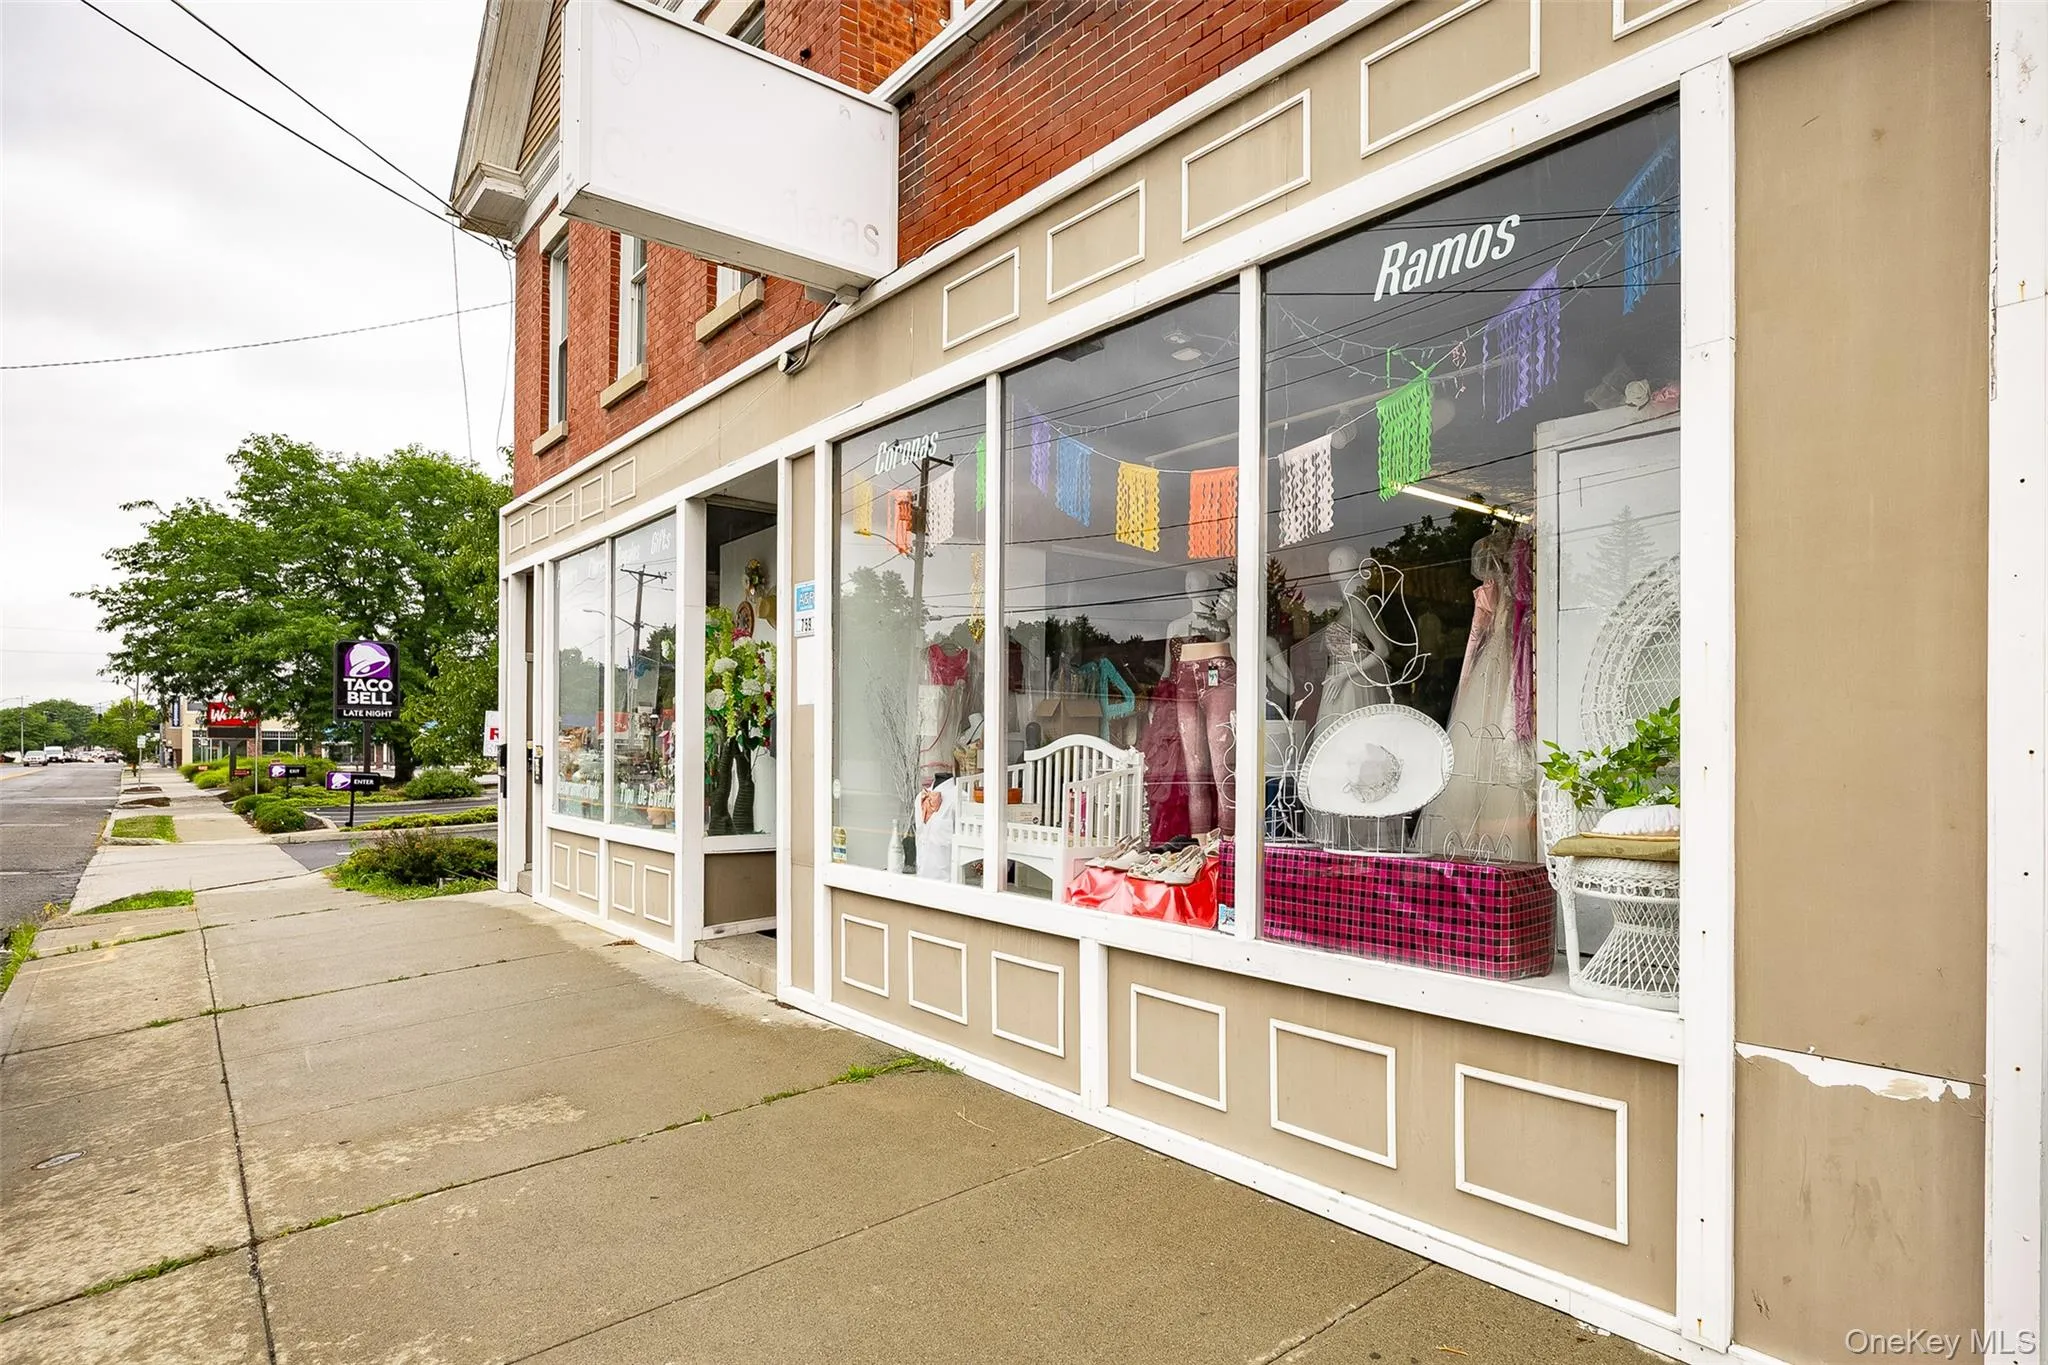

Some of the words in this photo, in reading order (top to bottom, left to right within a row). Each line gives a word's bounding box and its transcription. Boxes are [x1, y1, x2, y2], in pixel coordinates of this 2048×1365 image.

[1373, 214, 1521, 302] Ramos
[875, 431, 939, 475] Coronas
[343, 677, 393, 692] TACO
[347, 691, 392, 705] BELL
[343, 709, 363, 717] LATE
[365, 709, 393, 717] NIGHT
[353, 778, 375, 786] ENTER
